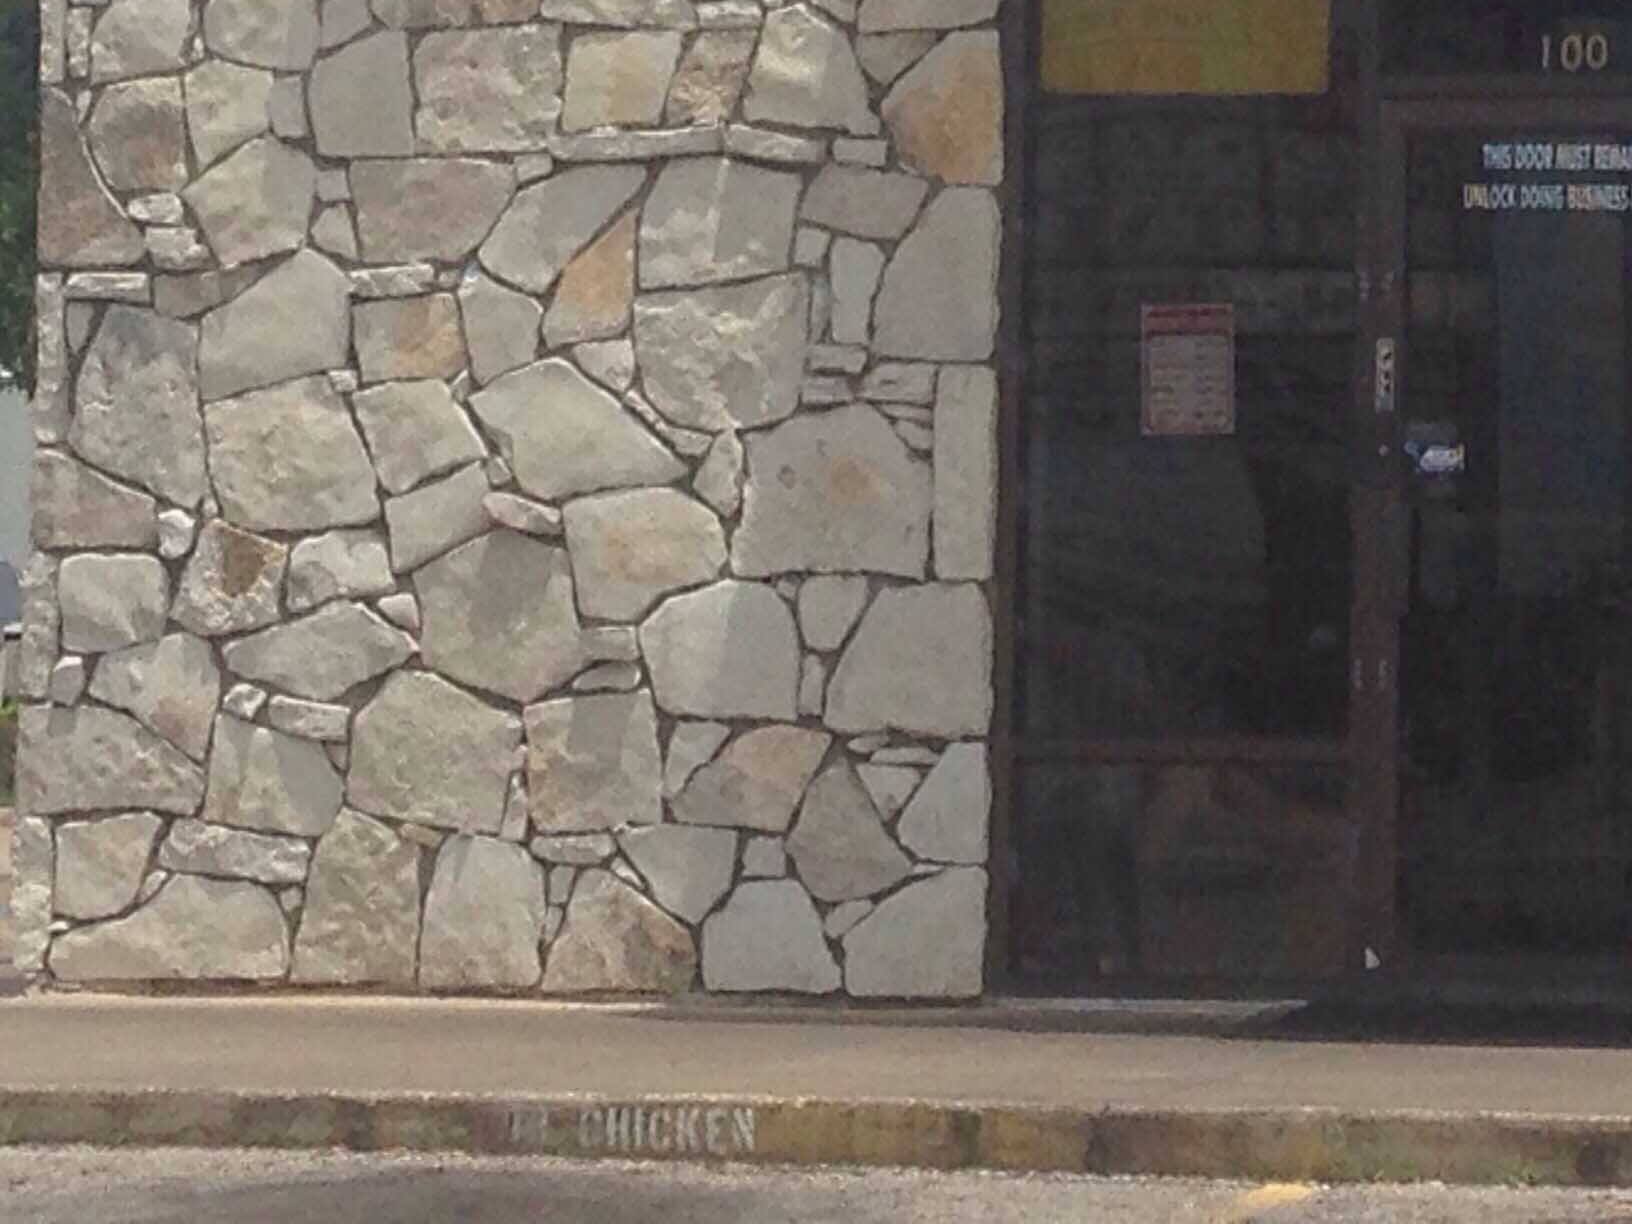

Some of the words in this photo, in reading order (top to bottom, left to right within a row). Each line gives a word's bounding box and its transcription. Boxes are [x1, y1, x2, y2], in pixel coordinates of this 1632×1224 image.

[1540, 35, 1608, 71] 100
[1482, 144, 1512, 170] THIS
[1514, 144, 1552, 170] DOOR
[1554, 144, 1591, 170] MUST
[1566, 184, 1629, 210] BUSINESS
[579, 1106, 756, 1154] CHICKEN
